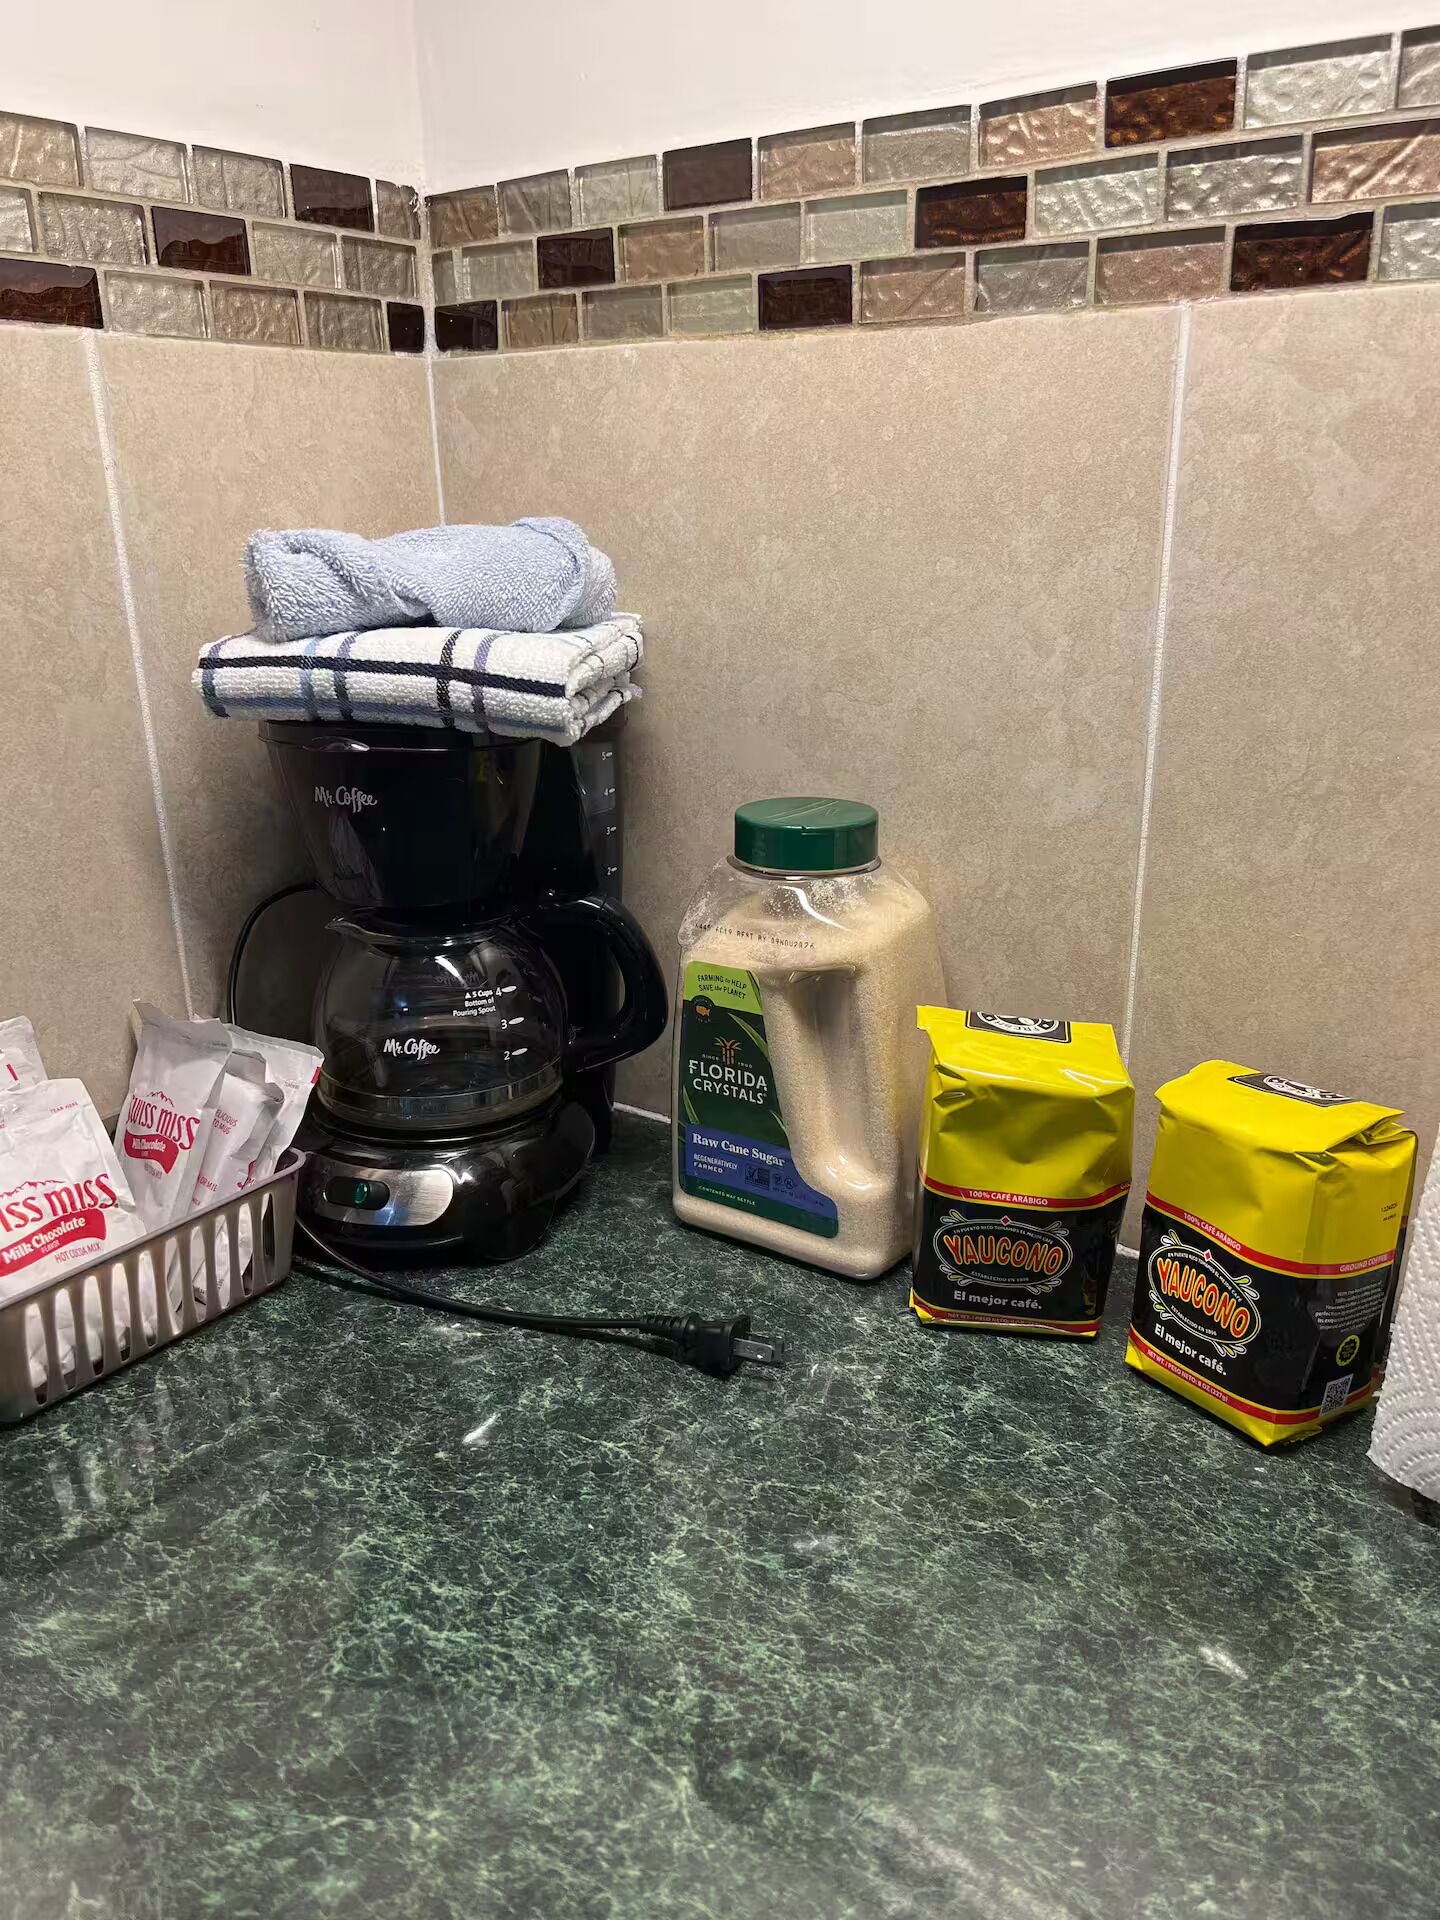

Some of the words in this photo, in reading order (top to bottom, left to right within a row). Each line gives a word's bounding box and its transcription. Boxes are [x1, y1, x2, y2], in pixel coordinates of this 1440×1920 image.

[314, 786, 335, 808] Mr.
[335, 785, 378, 813] Coffee
[697, 974, 724, 983] FARMING
[731, 979, 747, 990] HELP
[477, 989, 493, 998] Cups
[495, 987, 502, 997] 4
[698, 984, 714, 992] SAVE
[723, 986, 746, 1000] PLANET
[452, 1008, 478, 1017] Pouring
[478, 1005, 496, 1015] Spout
[464, 999, 488, 1008] Bottom
[500, 1019, 508, 1030] 3
[383, 1038, 403, 1057] Mr.
[403, 1038, 440, 1060] Coffee
[503, 1051, 511, 1061] 2
[688, 1059, 768, 1092] FLORIDA
[692, 1077, 764, 1105] CRYSTALS
[692, 1132, 719, 1149] Raw
[721, 1140, 750, 1156] Cane
[751, 1147, 785, 1167] Sugar
[693, 1153, 738, 1170] REGENERATIVELY
[693, 1161, 724, 1174] FARMED
[969, 1190, 990, 1200] 100%
[991, 1190, 1012, 1202] CAFÉ
[1012, 1192, 1048, 1206] ARÁBIGO
[1183, 1212, 1200, 1226] 100%
[1200, 1220, 1216, 1236] CAFÉ
[1215, 1230, 1242, 1252] ARÁBIGO
[2, 1243, 34, 1264] Milk
[31, 1217, 86, 1248] Chocolate
[54, 1252, 70, 1264] HOT
[943, 1234, 1063, 1276] YAUCONO
[1339, 1261, 1368, 1273] GROUND
[953, 1290, 965, 1300] El
[968, 1294, 1008, 1306] mejor
[1010, 1297, 1042, 1310] café.
[1157, 1257, 1250, 1338] YAUCONO
[1154, 1322, 1164, 1336] El
[1164, 1331, 1198, 1359] mejor
[1199, 1353, 1227, 1376] café.
[1167, 1363, 1182, 1376] PESO
